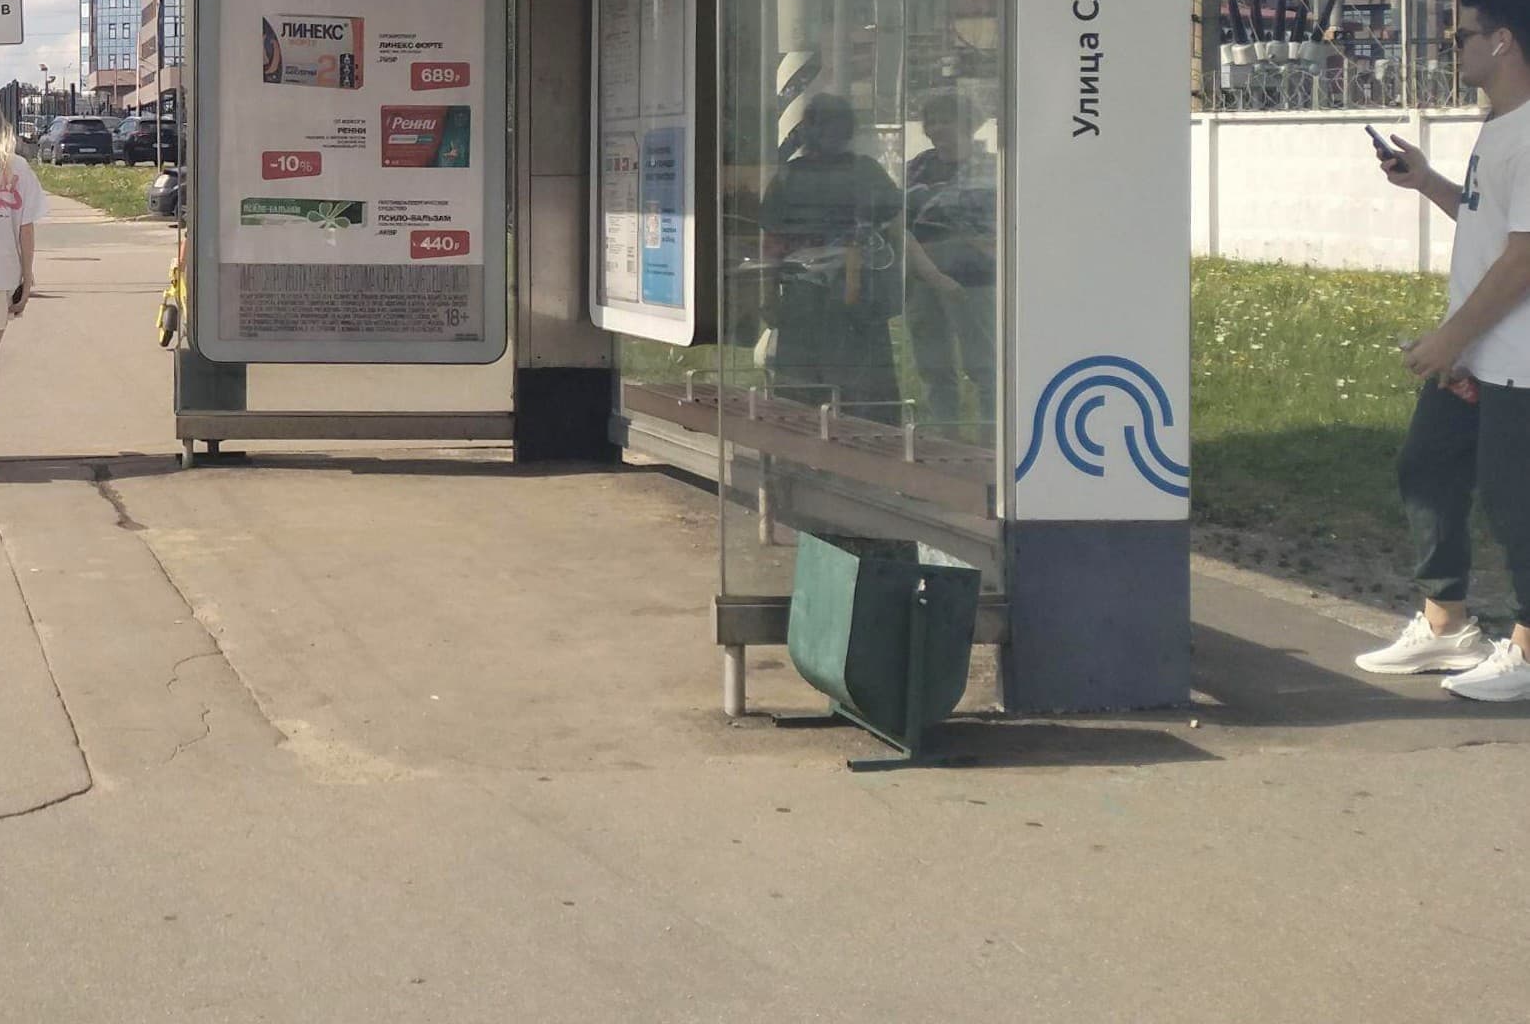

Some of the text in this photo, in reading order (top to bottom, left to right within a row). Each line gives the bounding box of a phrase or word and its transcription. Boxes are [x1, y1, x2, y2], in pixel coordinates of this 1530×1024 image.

[281, 22, 344, 40] ЛИНЕКС
[1073, 32, 1103, 137] Улица
[392, 116, 436, 130] Ренни
[445, 309, 469, 326] 18+
